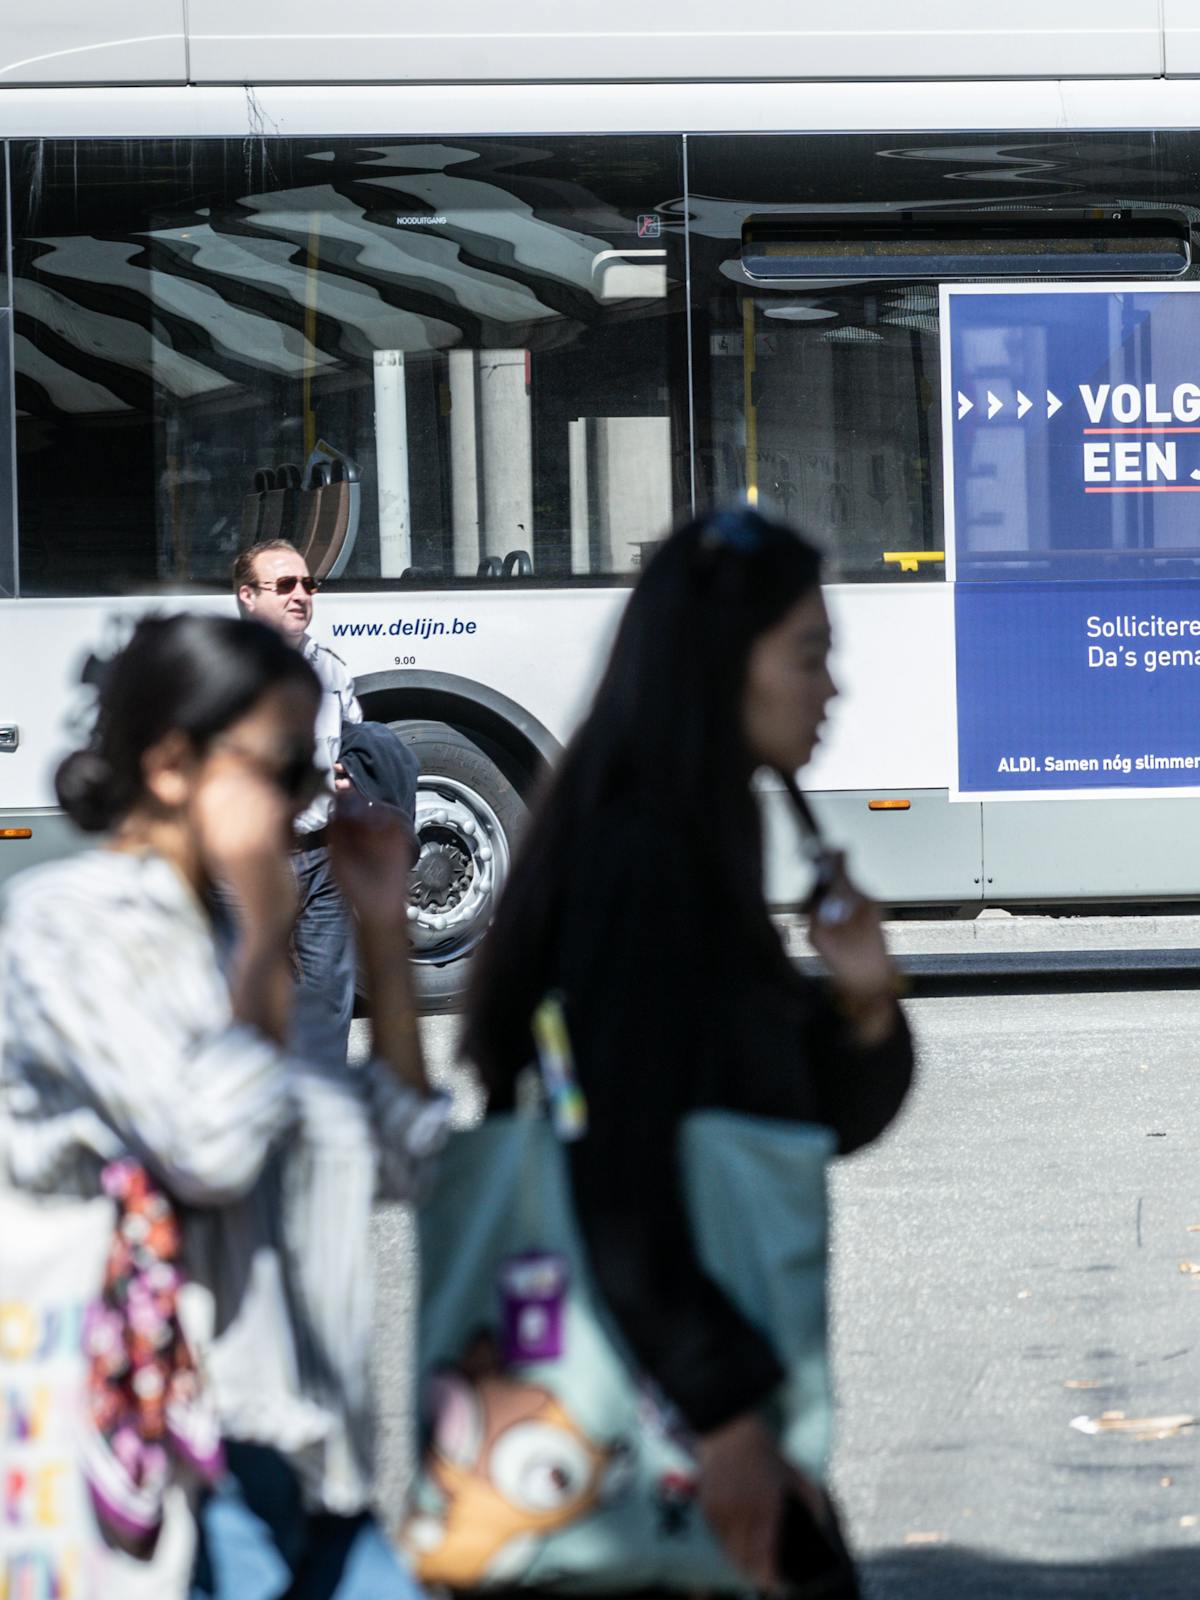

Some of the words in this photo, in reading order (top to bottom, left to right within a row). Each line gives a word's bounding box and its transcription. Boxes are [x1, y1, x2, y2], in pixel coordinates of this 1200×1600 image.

[396, 216, 447, 225] NOODUITGANG
[1083, 441, 1177, 482] EEN
[332, 618, 477, 640] www.delijn.be
[394, 656, 416, 665] 9.00
[1088, 645, 1138, 668] Da's
[998, 757, 1041, 773] ALDI.
[1044, 756, 1099, 772] Samen
[1102, 754, 1132, 774] nóg
